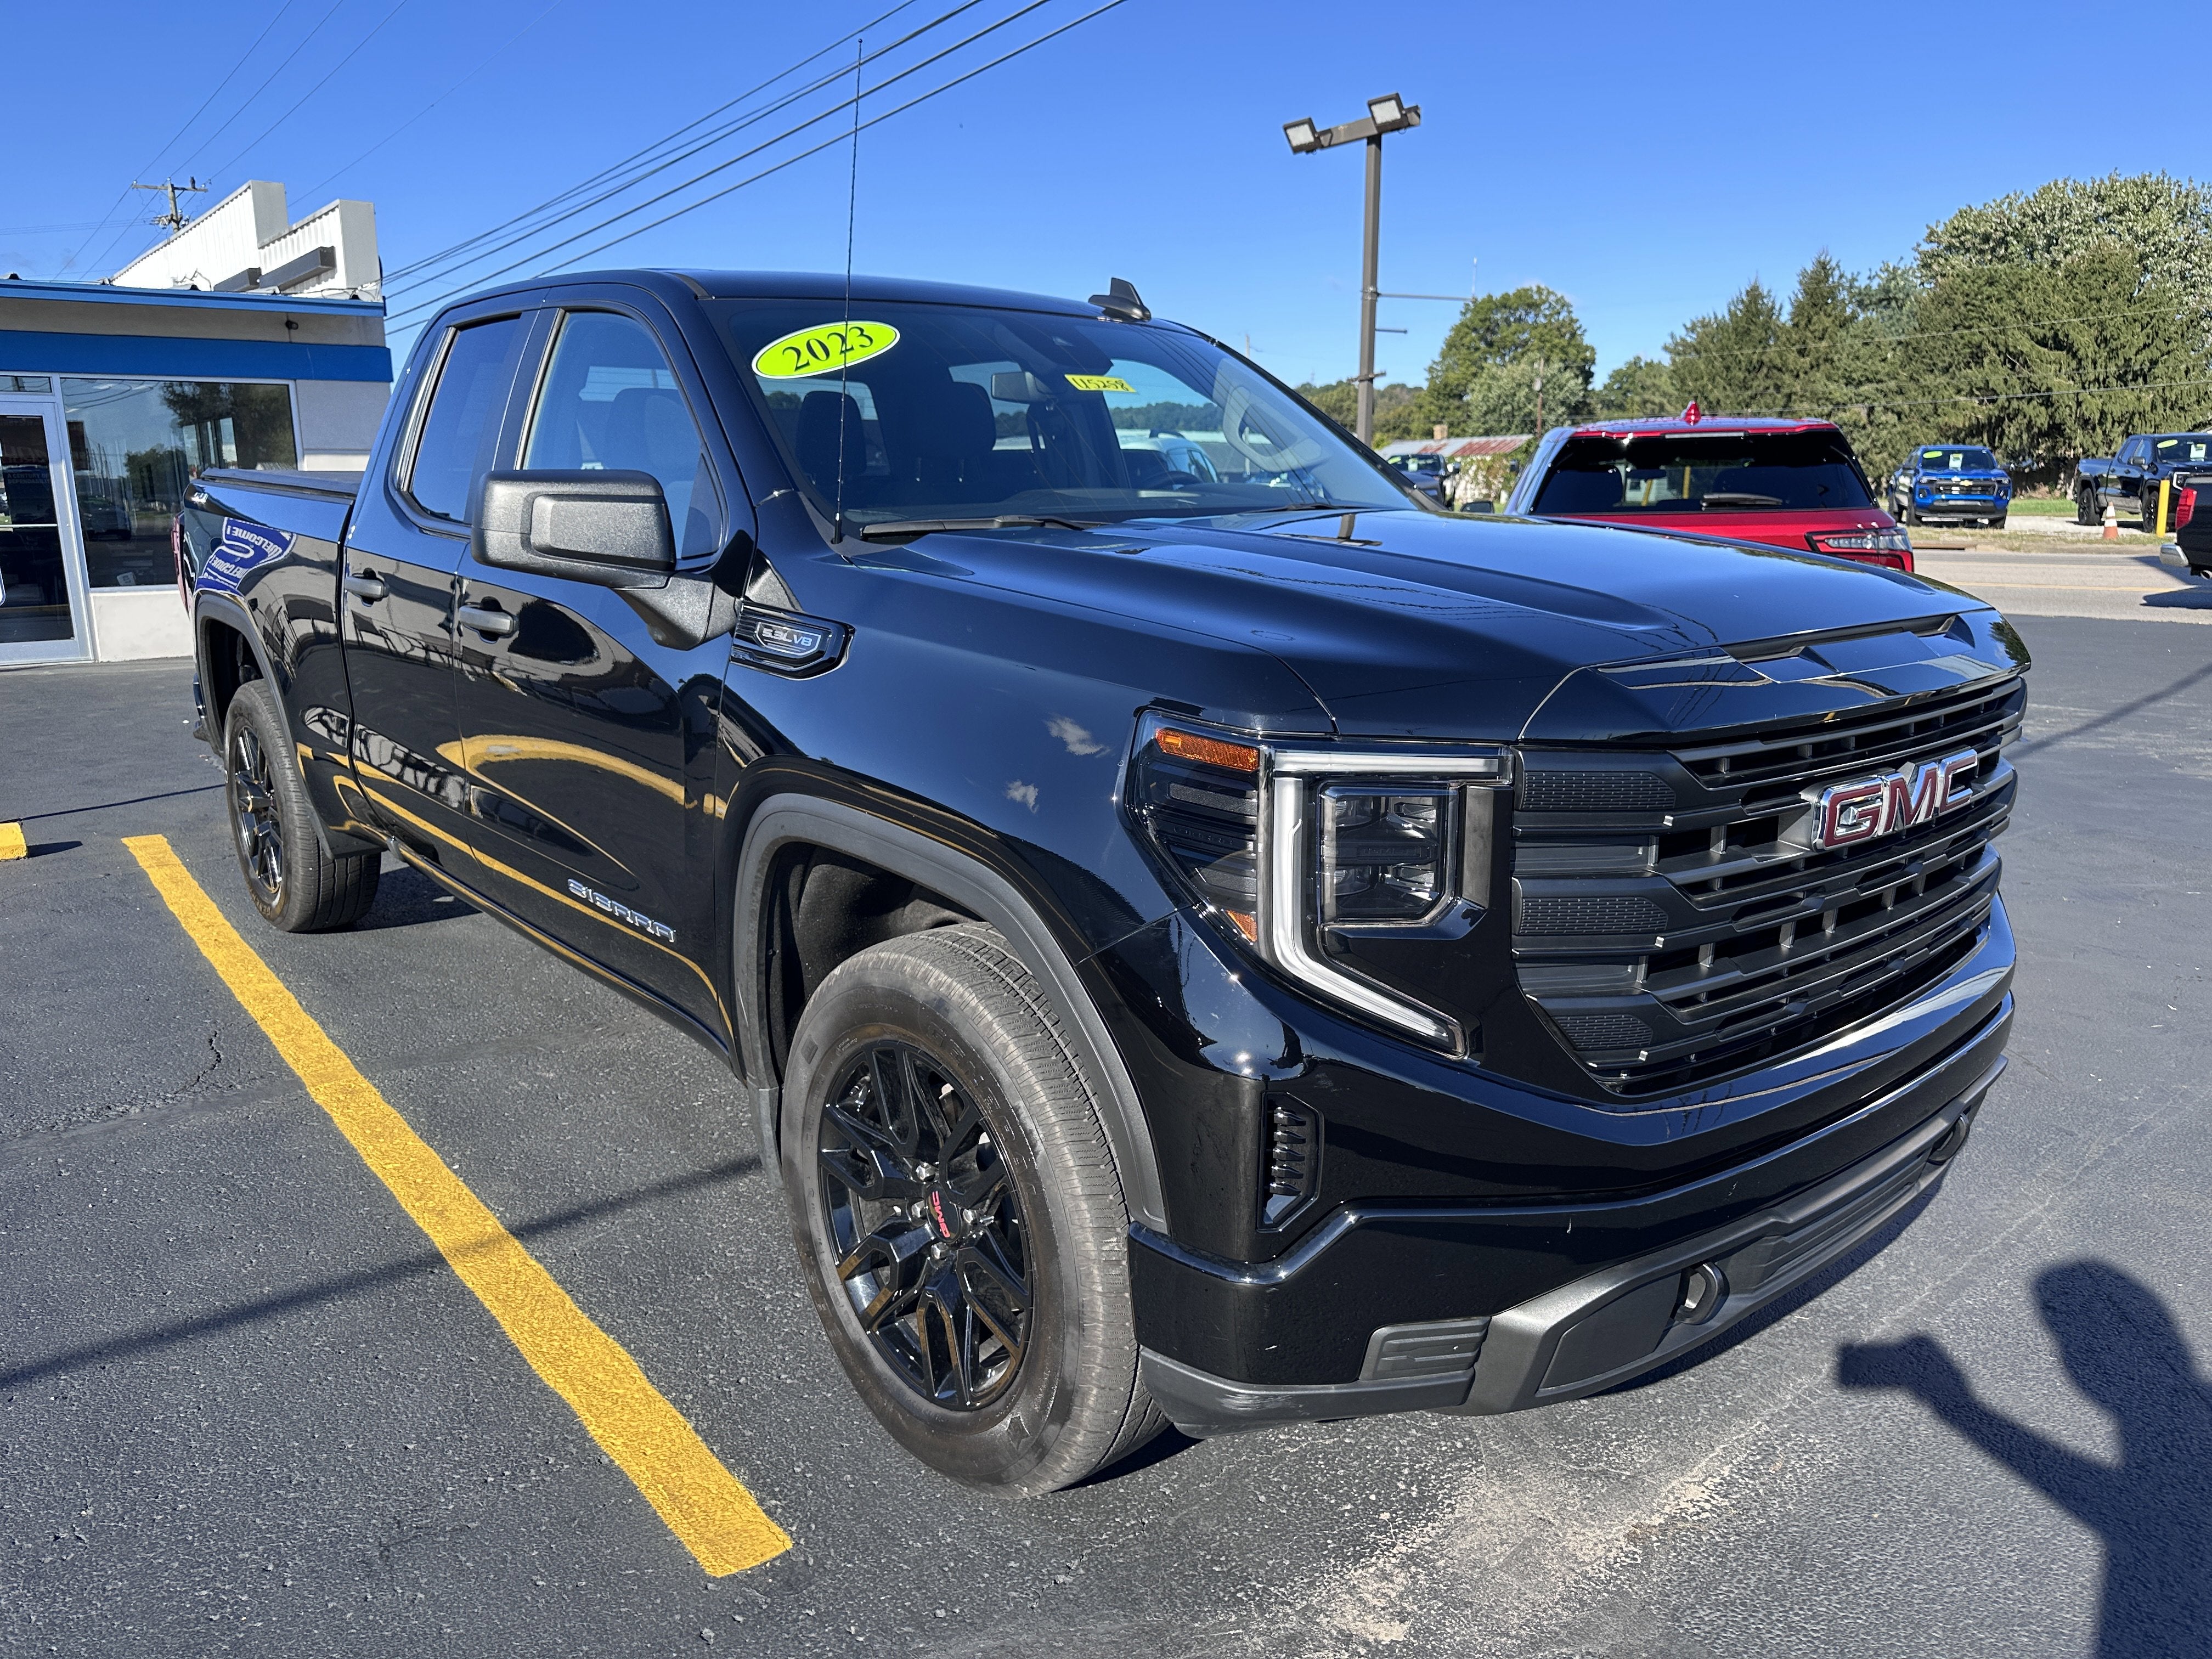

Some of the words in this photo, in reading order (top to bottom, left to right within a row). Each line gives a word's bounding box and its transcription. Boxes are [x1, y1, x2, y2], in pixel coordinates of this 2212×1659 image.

[782, 326, 873, 371] 2023
[793, 634, 812, 646] V8
[1811, 748, 1978, 852] GMC
[567, 878, 676, 943] SIERRA
[932, 1190, 950, 1238] GMC
